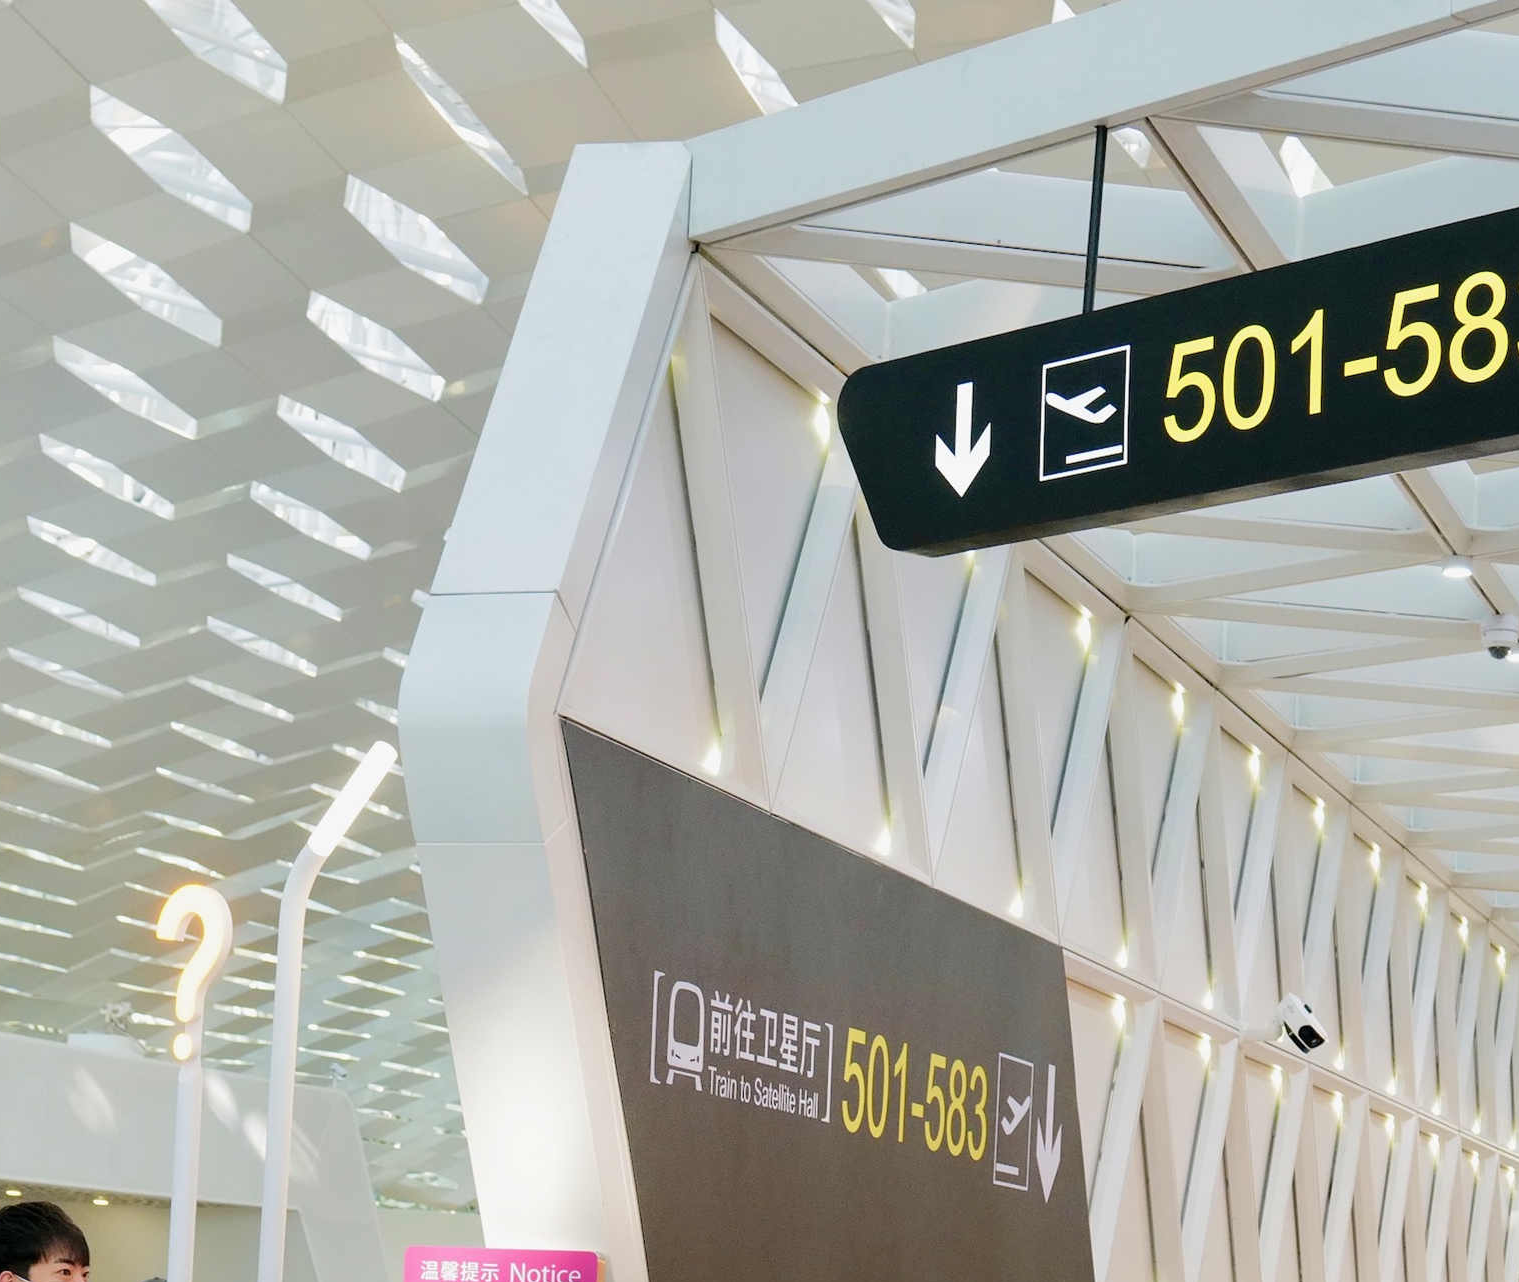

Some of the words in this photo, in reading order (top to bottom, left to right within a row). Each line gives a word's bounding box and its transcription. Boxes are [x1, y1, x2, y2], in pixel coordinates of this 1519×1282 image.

[710, 991, 822, 1079] 前往卫星厅
[707, 1065, 737, 1098] Train
[739, 1078, 751, 1103] to
[754, 1078, 796, 1115] Satellite
[798, 1094, 819, 1119] Hall
[842, 1027, 988, 1161] 501-583
